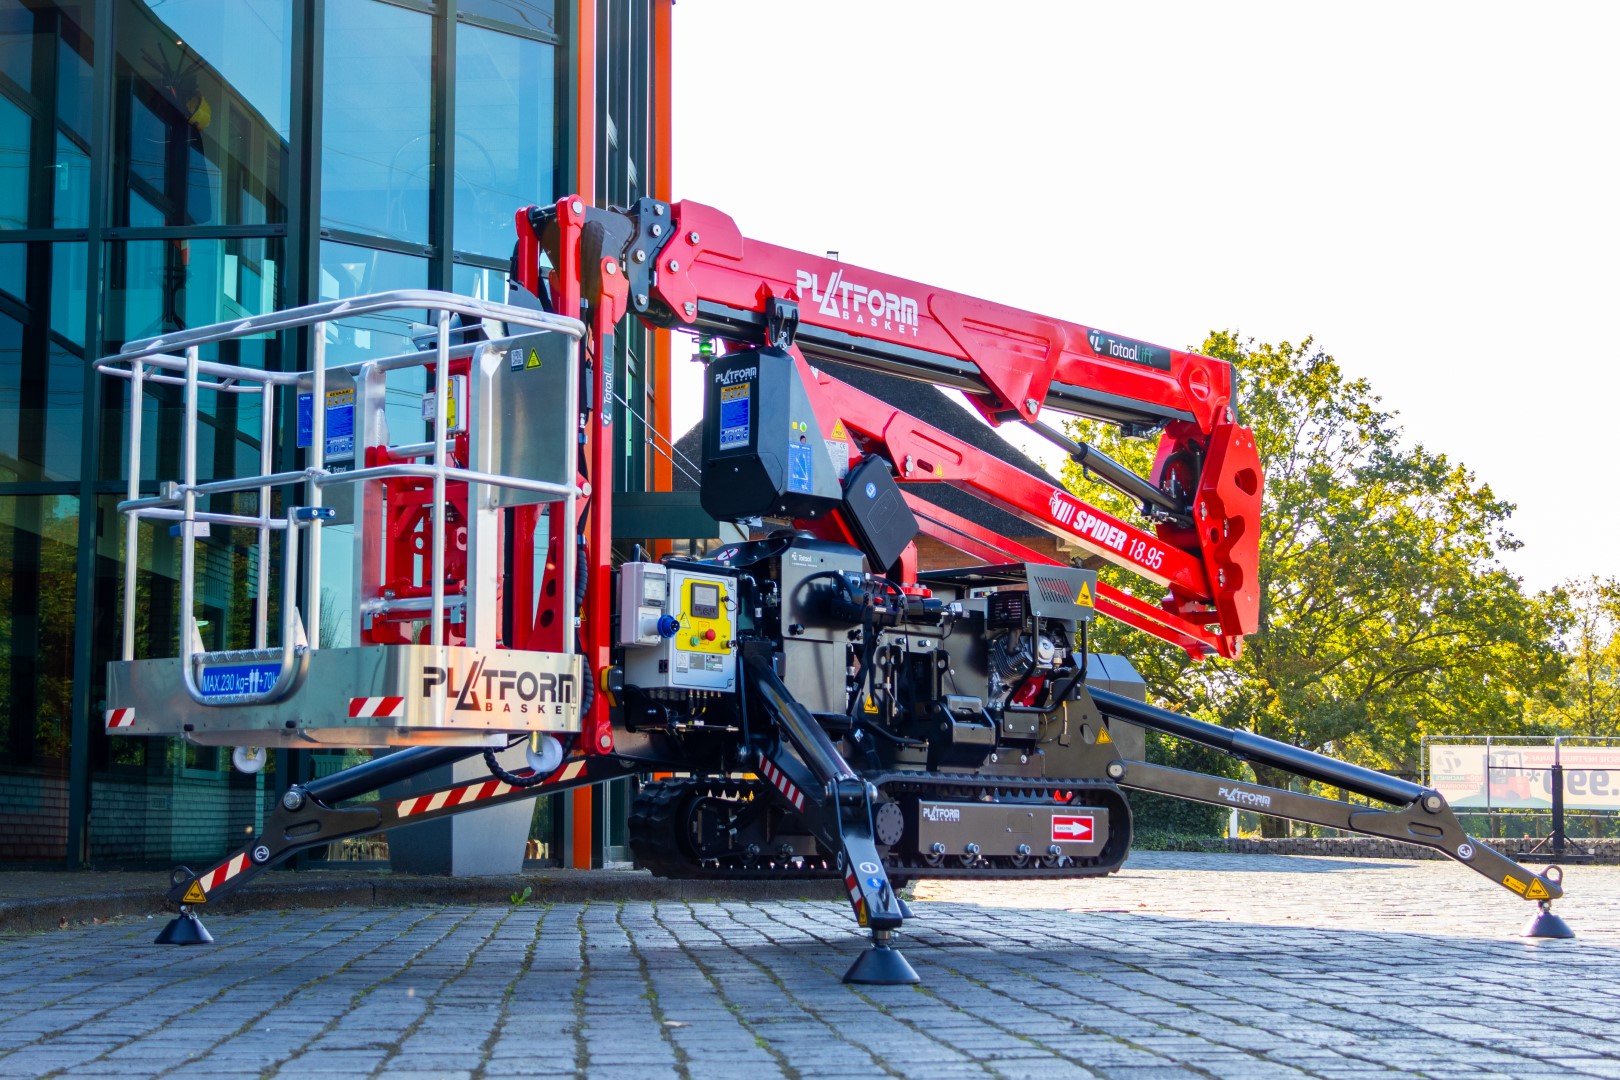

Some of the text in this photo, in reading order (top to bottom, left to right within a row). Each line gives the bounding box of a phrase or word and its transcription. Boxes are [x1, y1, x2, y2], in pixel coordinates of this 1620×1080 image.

[796, 268, 918, 327] PLATFORM
[842, 310, 918, 337] BASKET
[1107, 338, 1153, 365] Totaallift
[715, 366, 757, 385] PLATFORM
[1072, 510, 1165, 569] SPIDER 18.95
[423, 656, 577, 711] PLATFORM
[485, 703, 577, 715] BASKET
[1218, 787, 1271, 805] PLATFORM
[922, 804, 960, 821] PLATFORM
